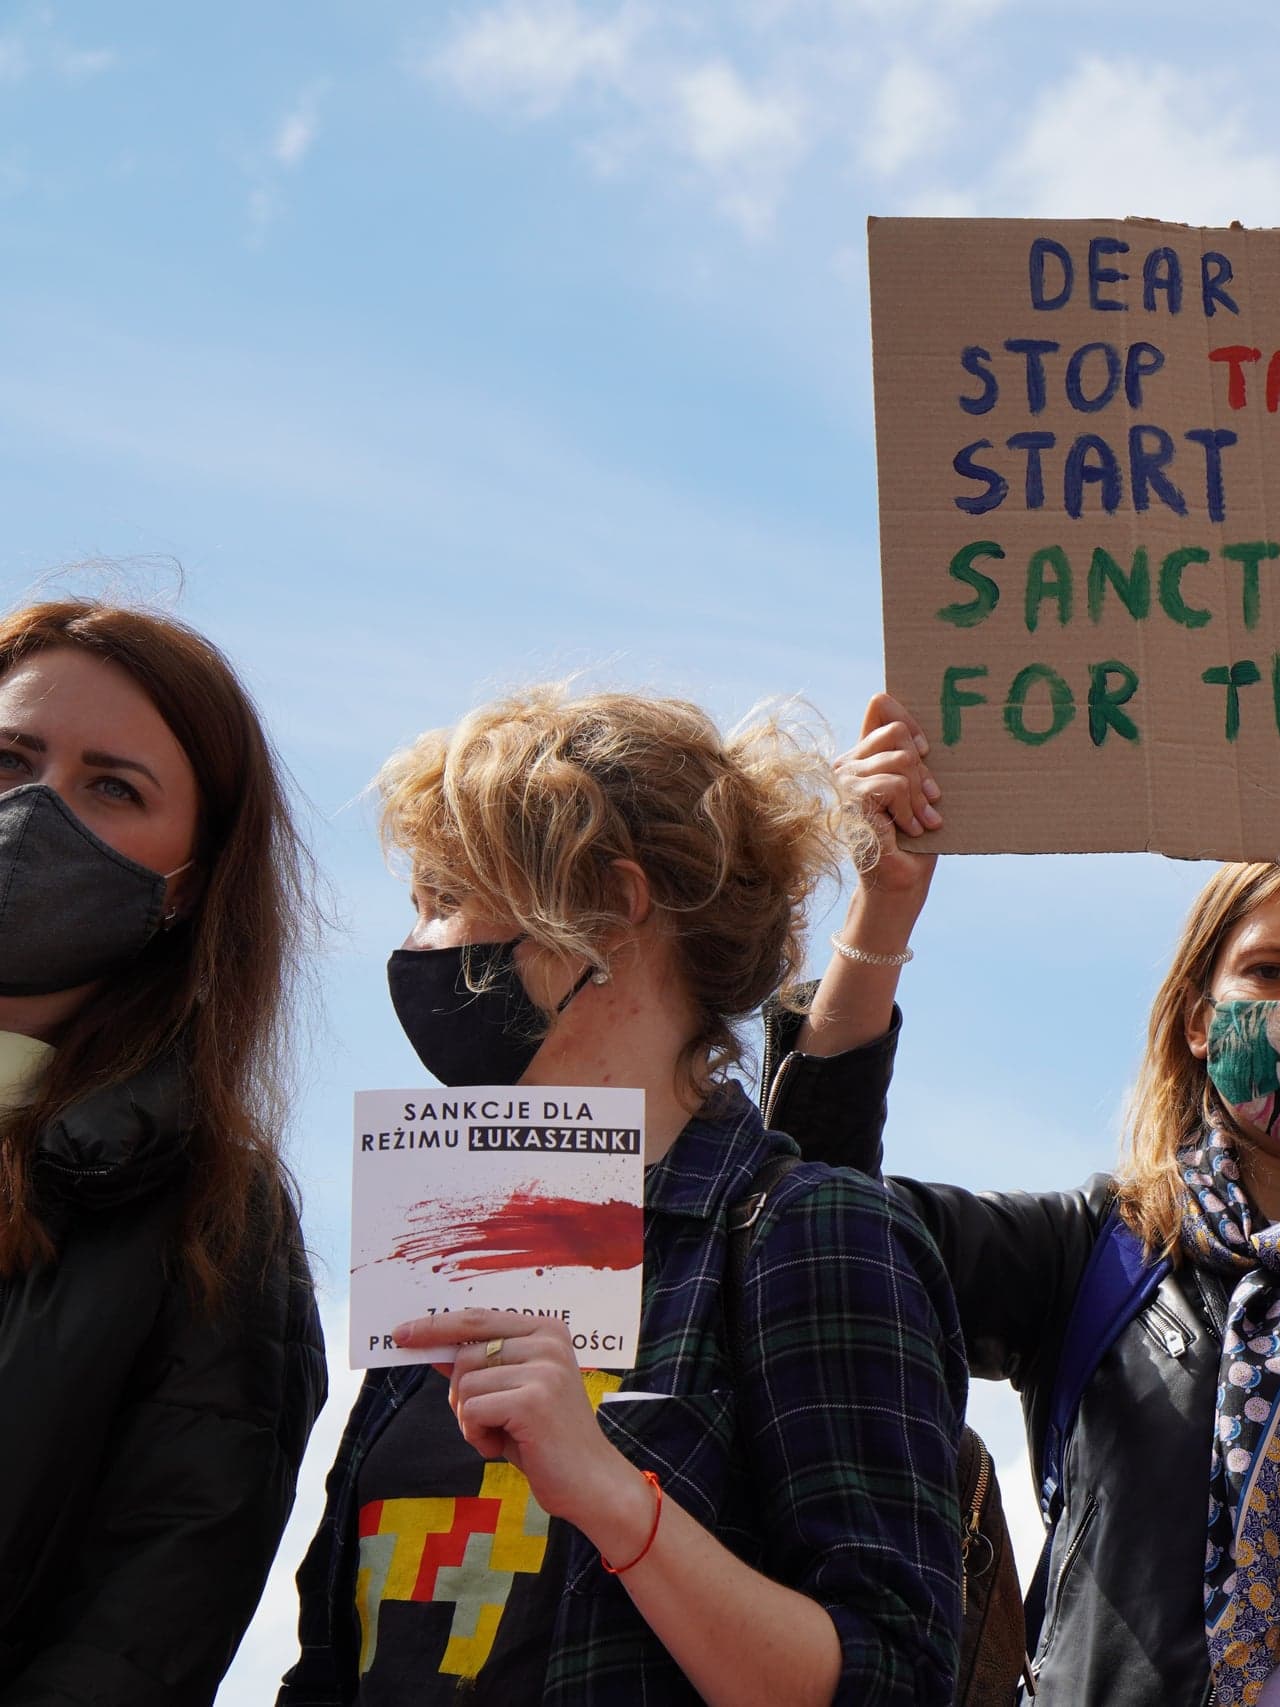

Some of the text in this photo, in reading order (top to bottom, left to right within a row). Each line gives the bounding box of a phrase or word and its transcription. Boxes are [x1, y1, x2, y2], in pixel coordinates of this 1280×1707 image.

[1030, 236, 1239, 317] DEAR
[958, 339, 1165, 416] STOP
[953, 424, 1238, 522] START
[940, 660, 1141, 747] FOR
[361, 1127, 636, 1152] REŻIMU ŁUKASZENKI
[404, 1100, 594, 1121] SANKCJE DLA
